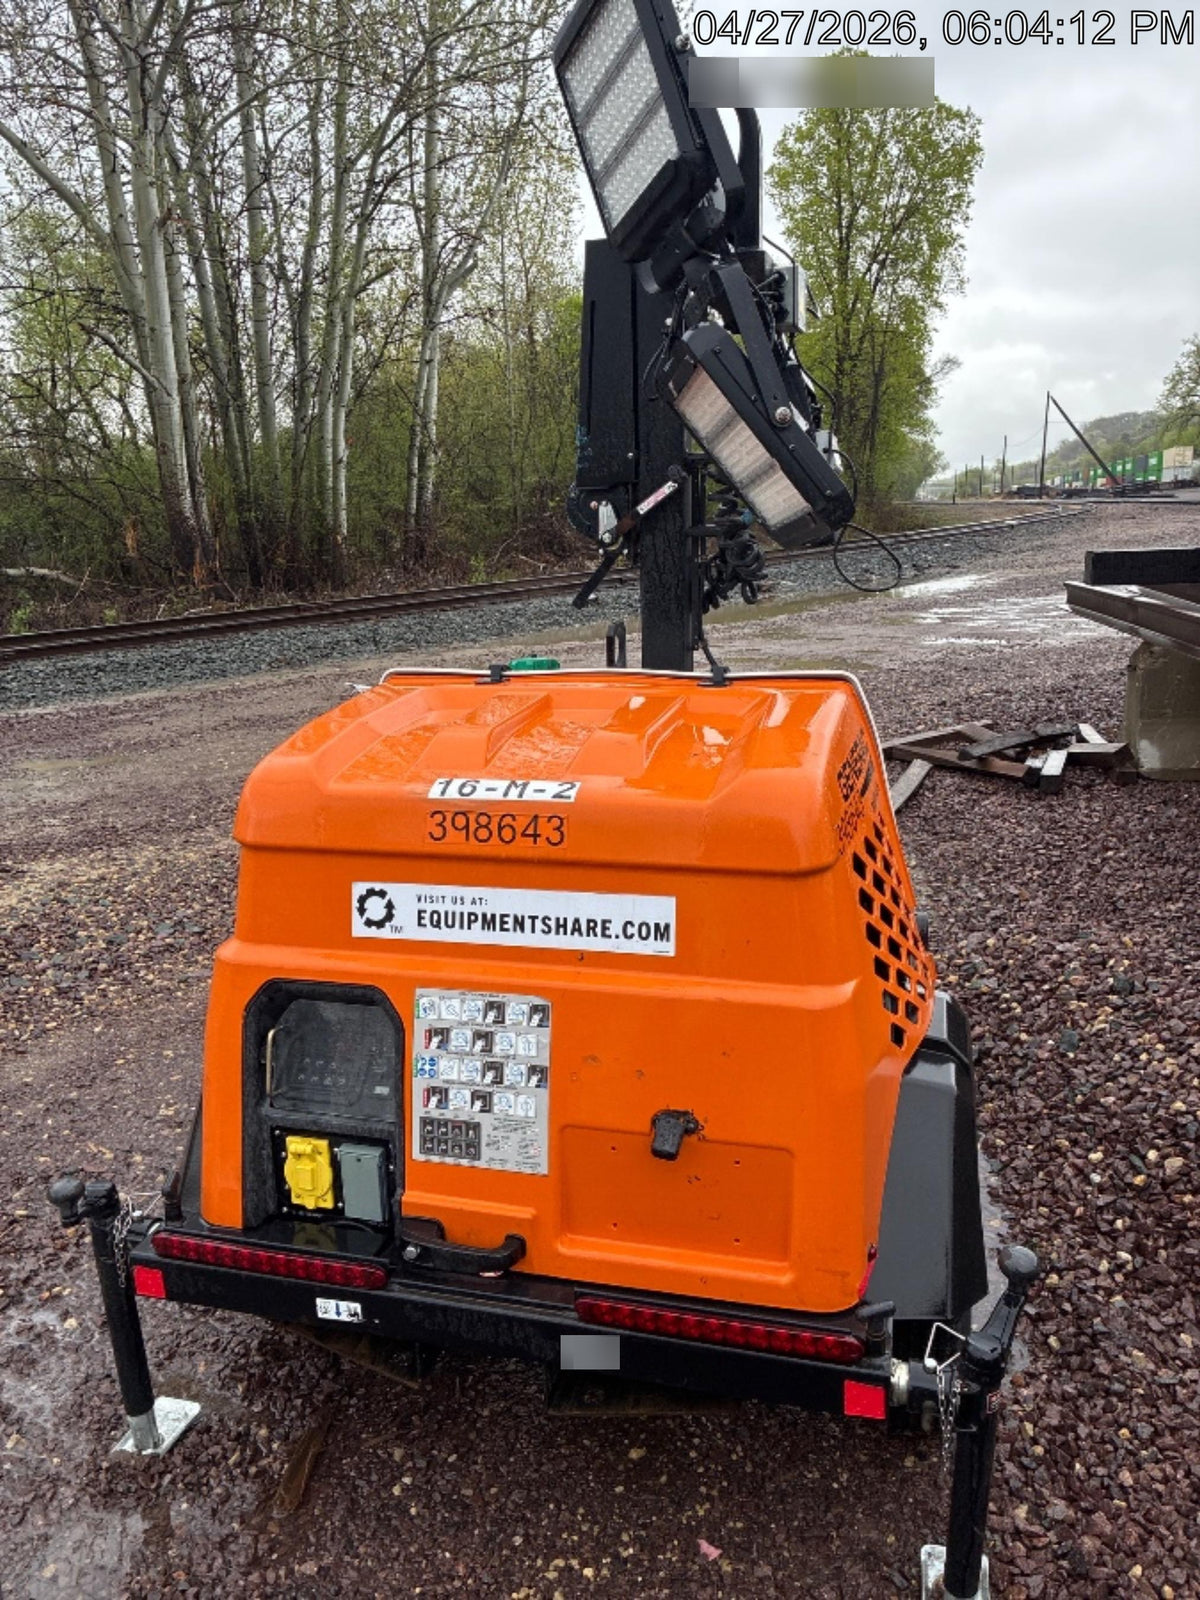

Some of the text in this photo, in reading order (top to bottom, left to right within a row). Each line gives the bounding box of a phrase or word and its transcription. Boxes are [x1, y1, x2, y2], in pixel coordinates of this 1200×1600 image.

[438, 778, 577, 800] 16-M-2
[428, 810, 565, 847] 398643
[416, 894, 488, 906] VISIT US AT:
[416, 909, 671, 943] EQUIPMENTSHARE.COM
